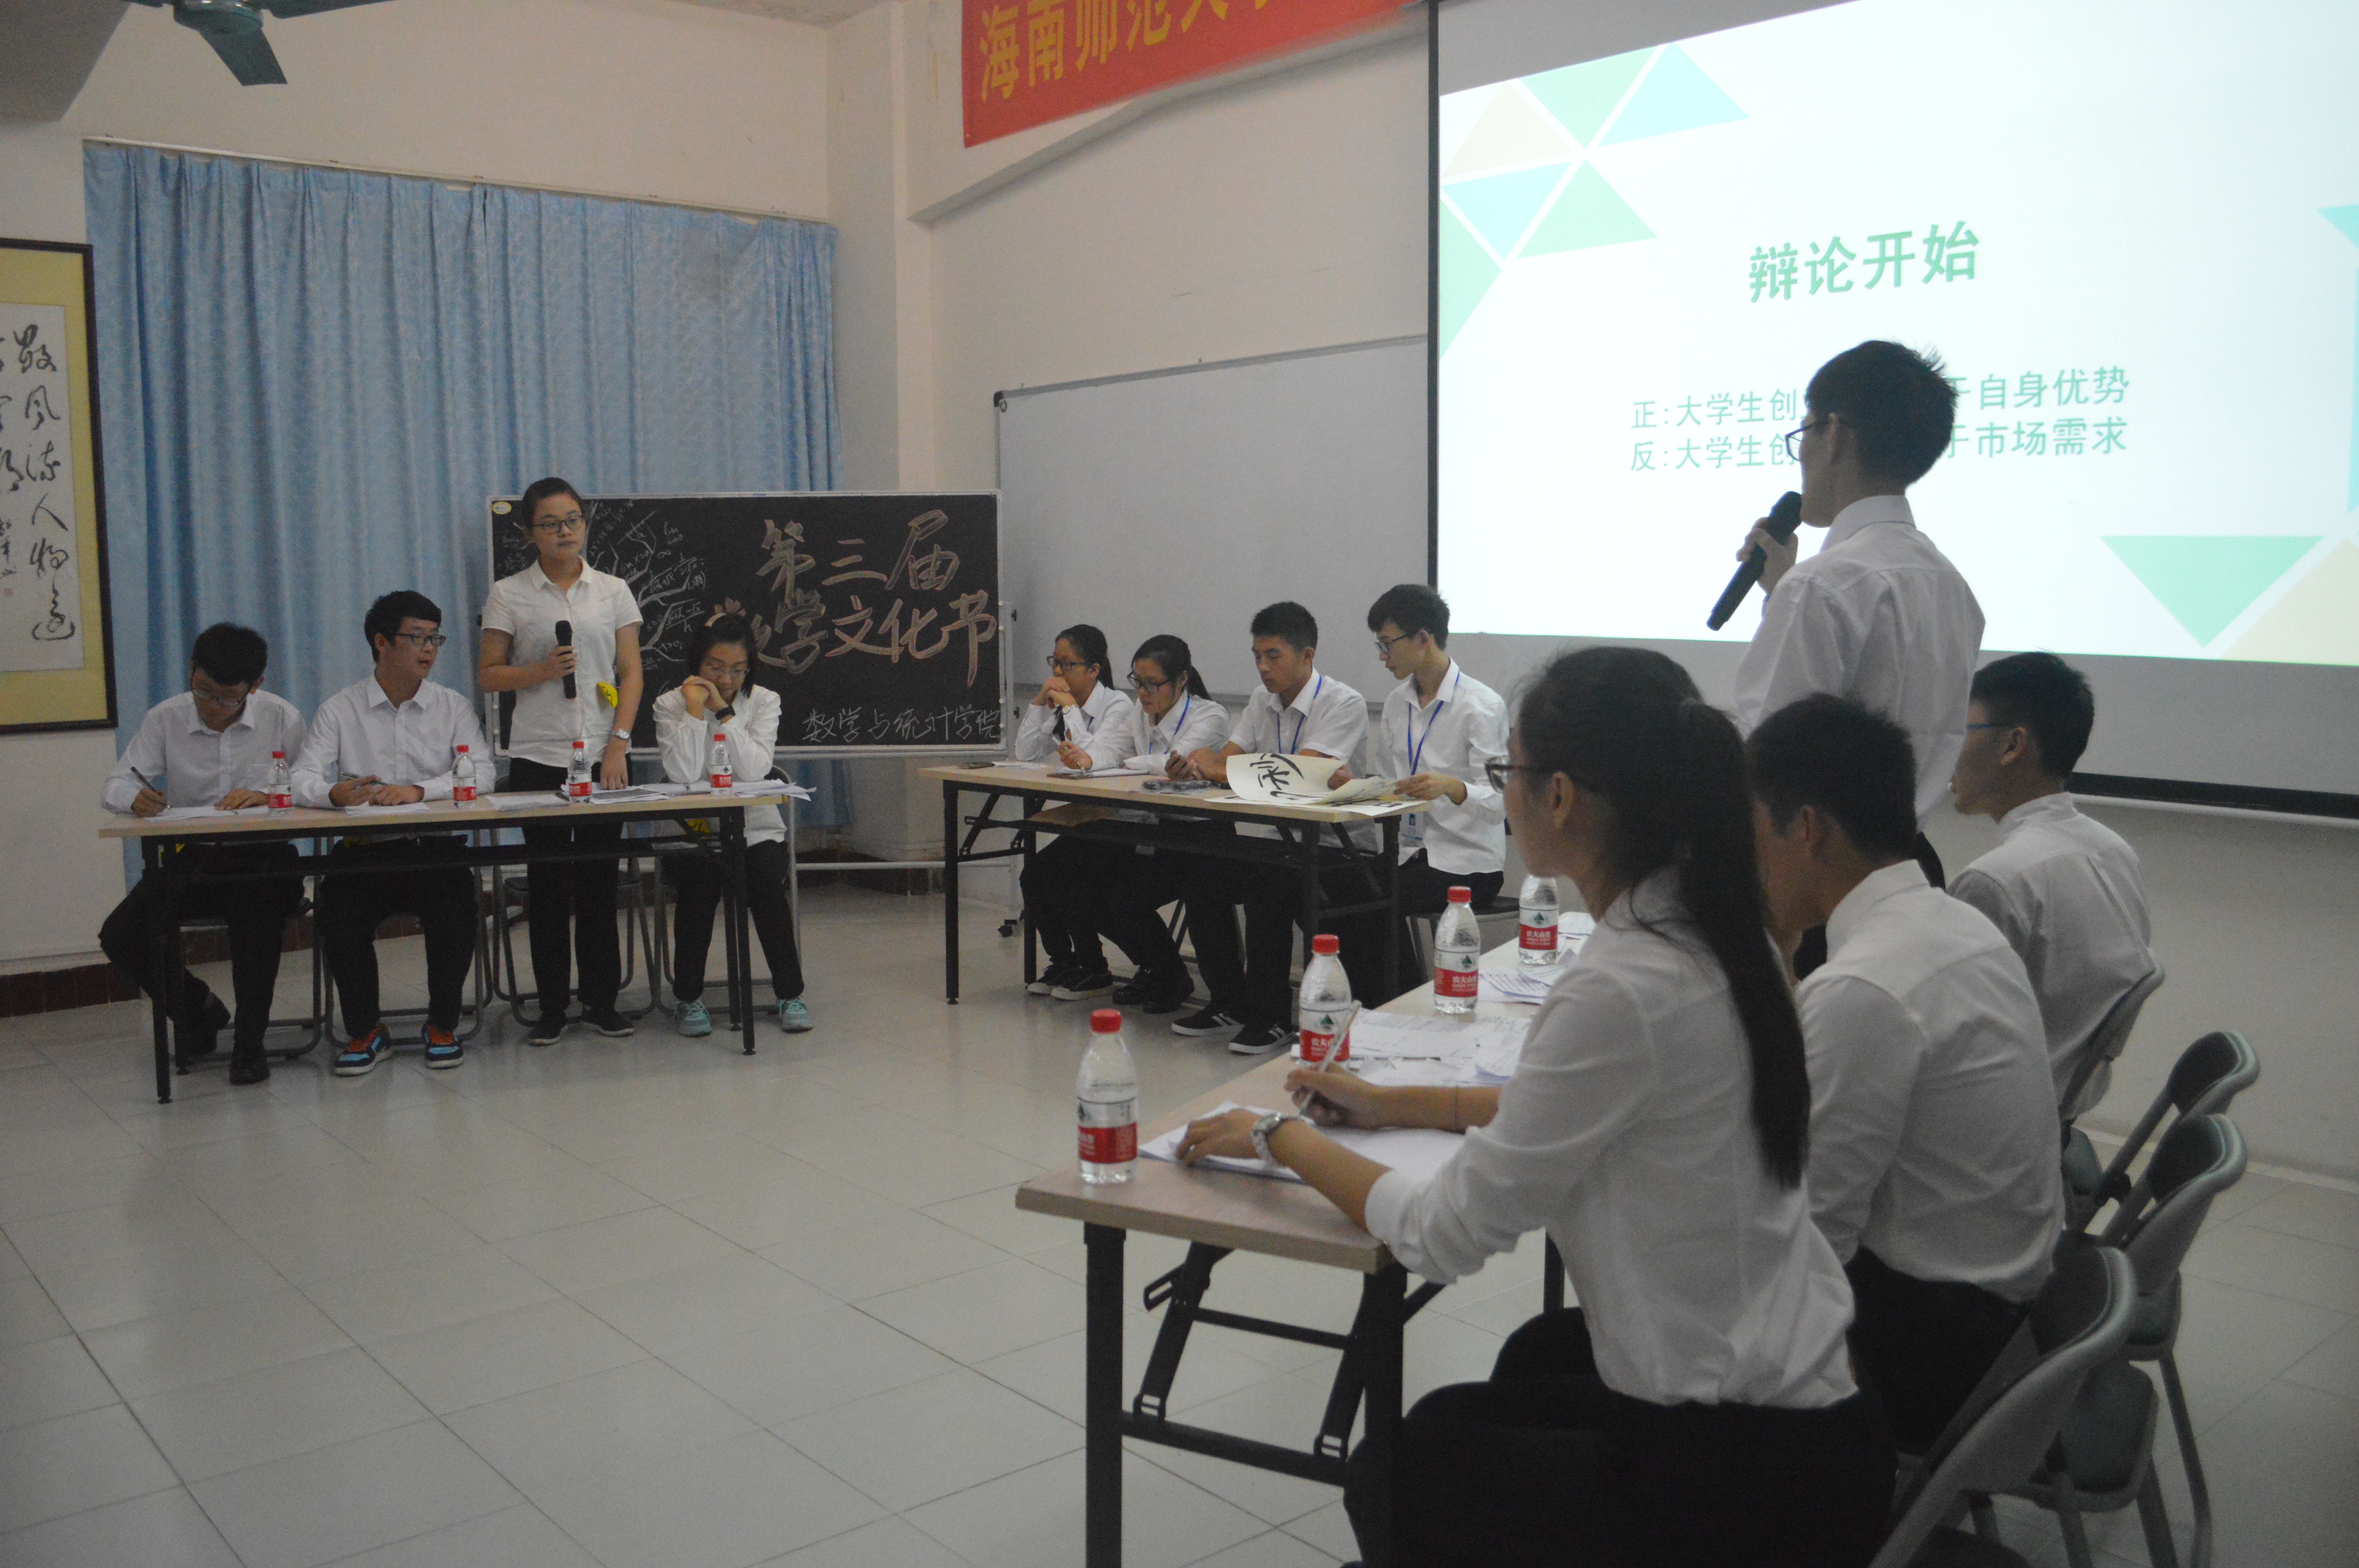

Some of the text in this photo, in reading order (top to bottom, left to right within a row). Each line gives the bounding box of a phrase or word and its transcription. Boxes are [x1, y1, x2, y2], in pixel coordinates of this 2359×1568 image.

[1749, 220, 1979, 303] 辩论开始
[756, 510, 960, 600] 第三届
[802, 704, 1000, 743] 数学与统计学院
